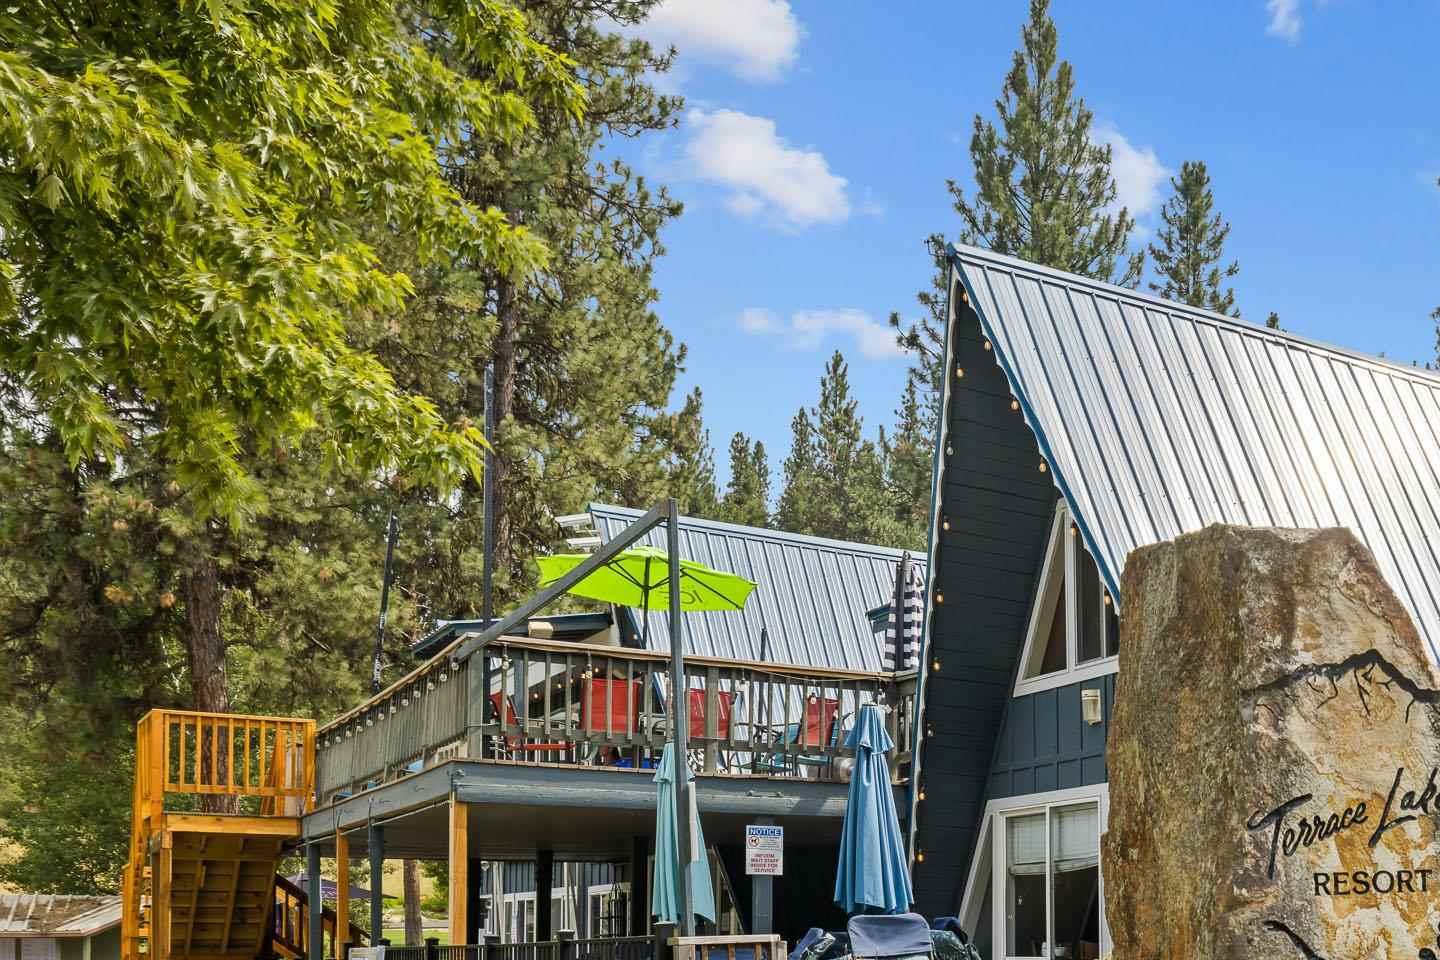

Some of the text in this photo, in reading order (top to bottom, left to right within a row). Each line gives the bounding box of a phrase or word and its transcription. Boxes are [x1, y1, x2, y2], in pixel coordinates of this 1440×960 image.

[750, 828, 781, 836] NOTICE
[1247, 793, 1368, 881] Terrace
[1313, 869, 1433, 896] RESORT
